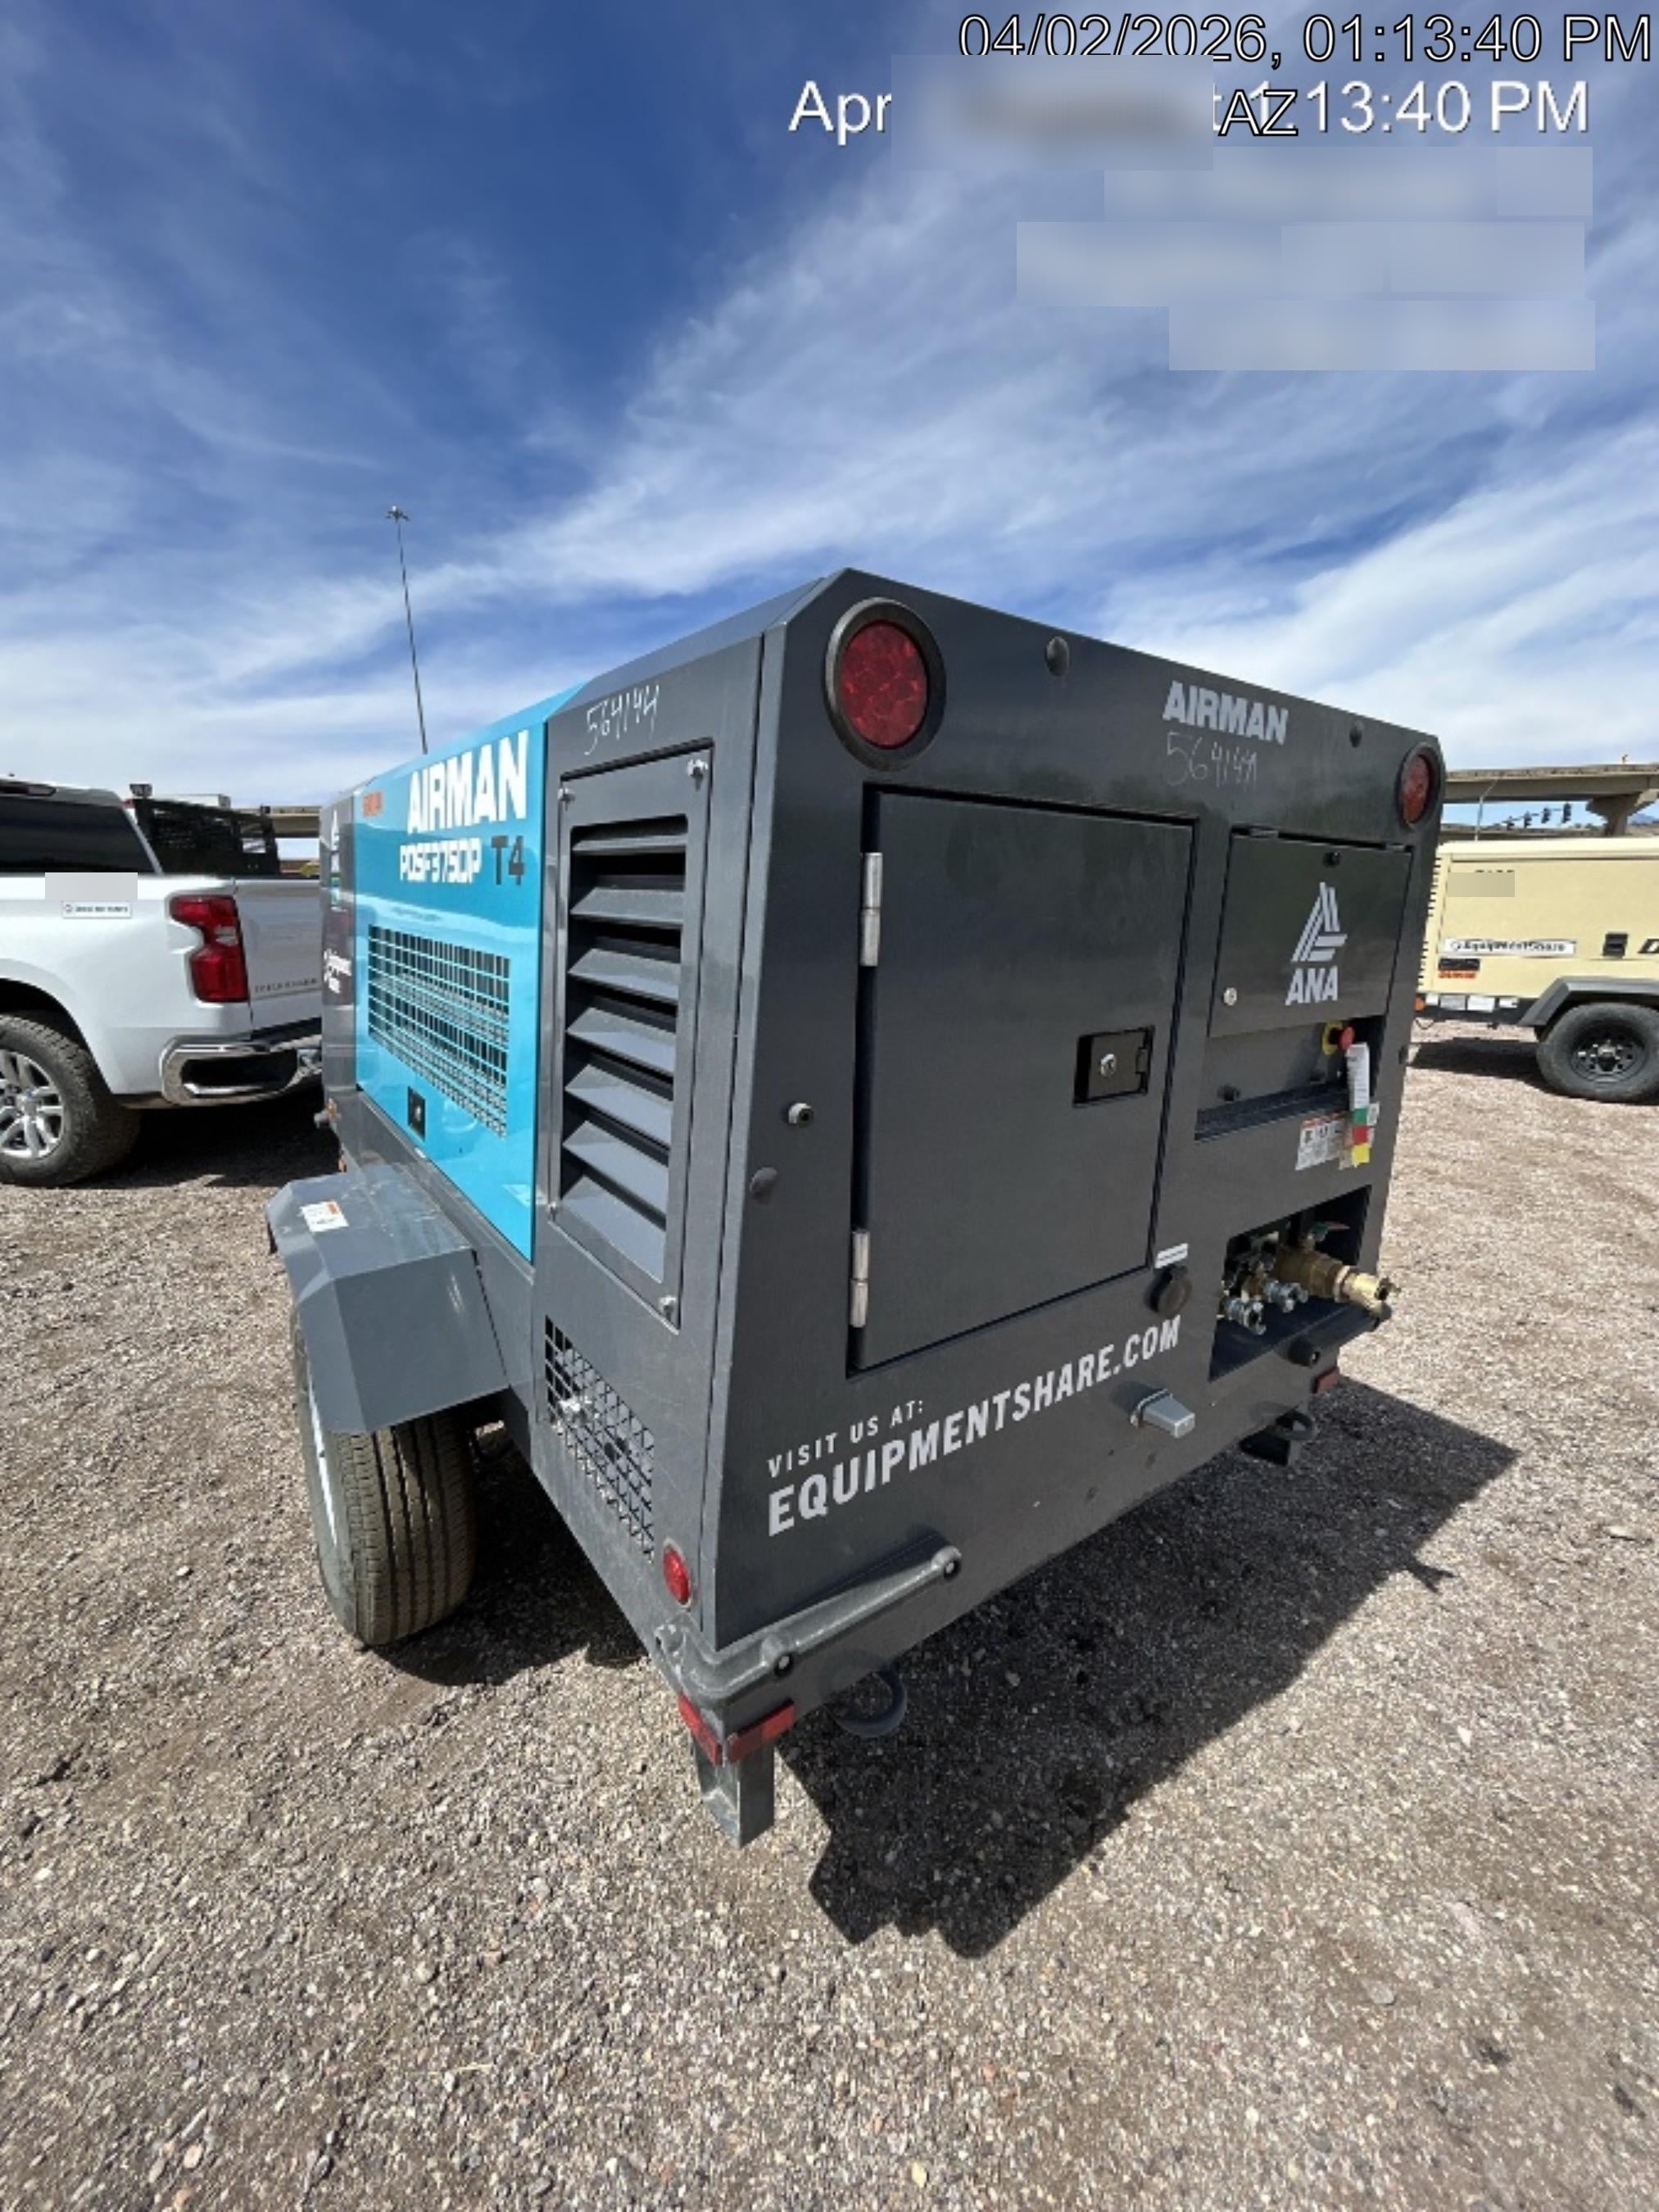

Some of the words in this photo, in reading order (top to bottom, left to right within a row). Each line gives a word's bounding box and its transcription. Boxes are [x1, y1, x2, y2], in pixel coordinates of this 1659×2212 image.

[1163, 681, 1289, 745] AIRMAN
[407, 730, 529, 835] AIRMAN
[492, 835, 525, 886] T4
[1285, 966, 1339, 1006] ANA
[768, 1315, 1181, 1537] EQUIPMENTSHARE.COM
[768, 1432, 838, 1479] VISIT
[850, 1415, 879, 1444] US
[890, 1400, 923, 1428] AT:
